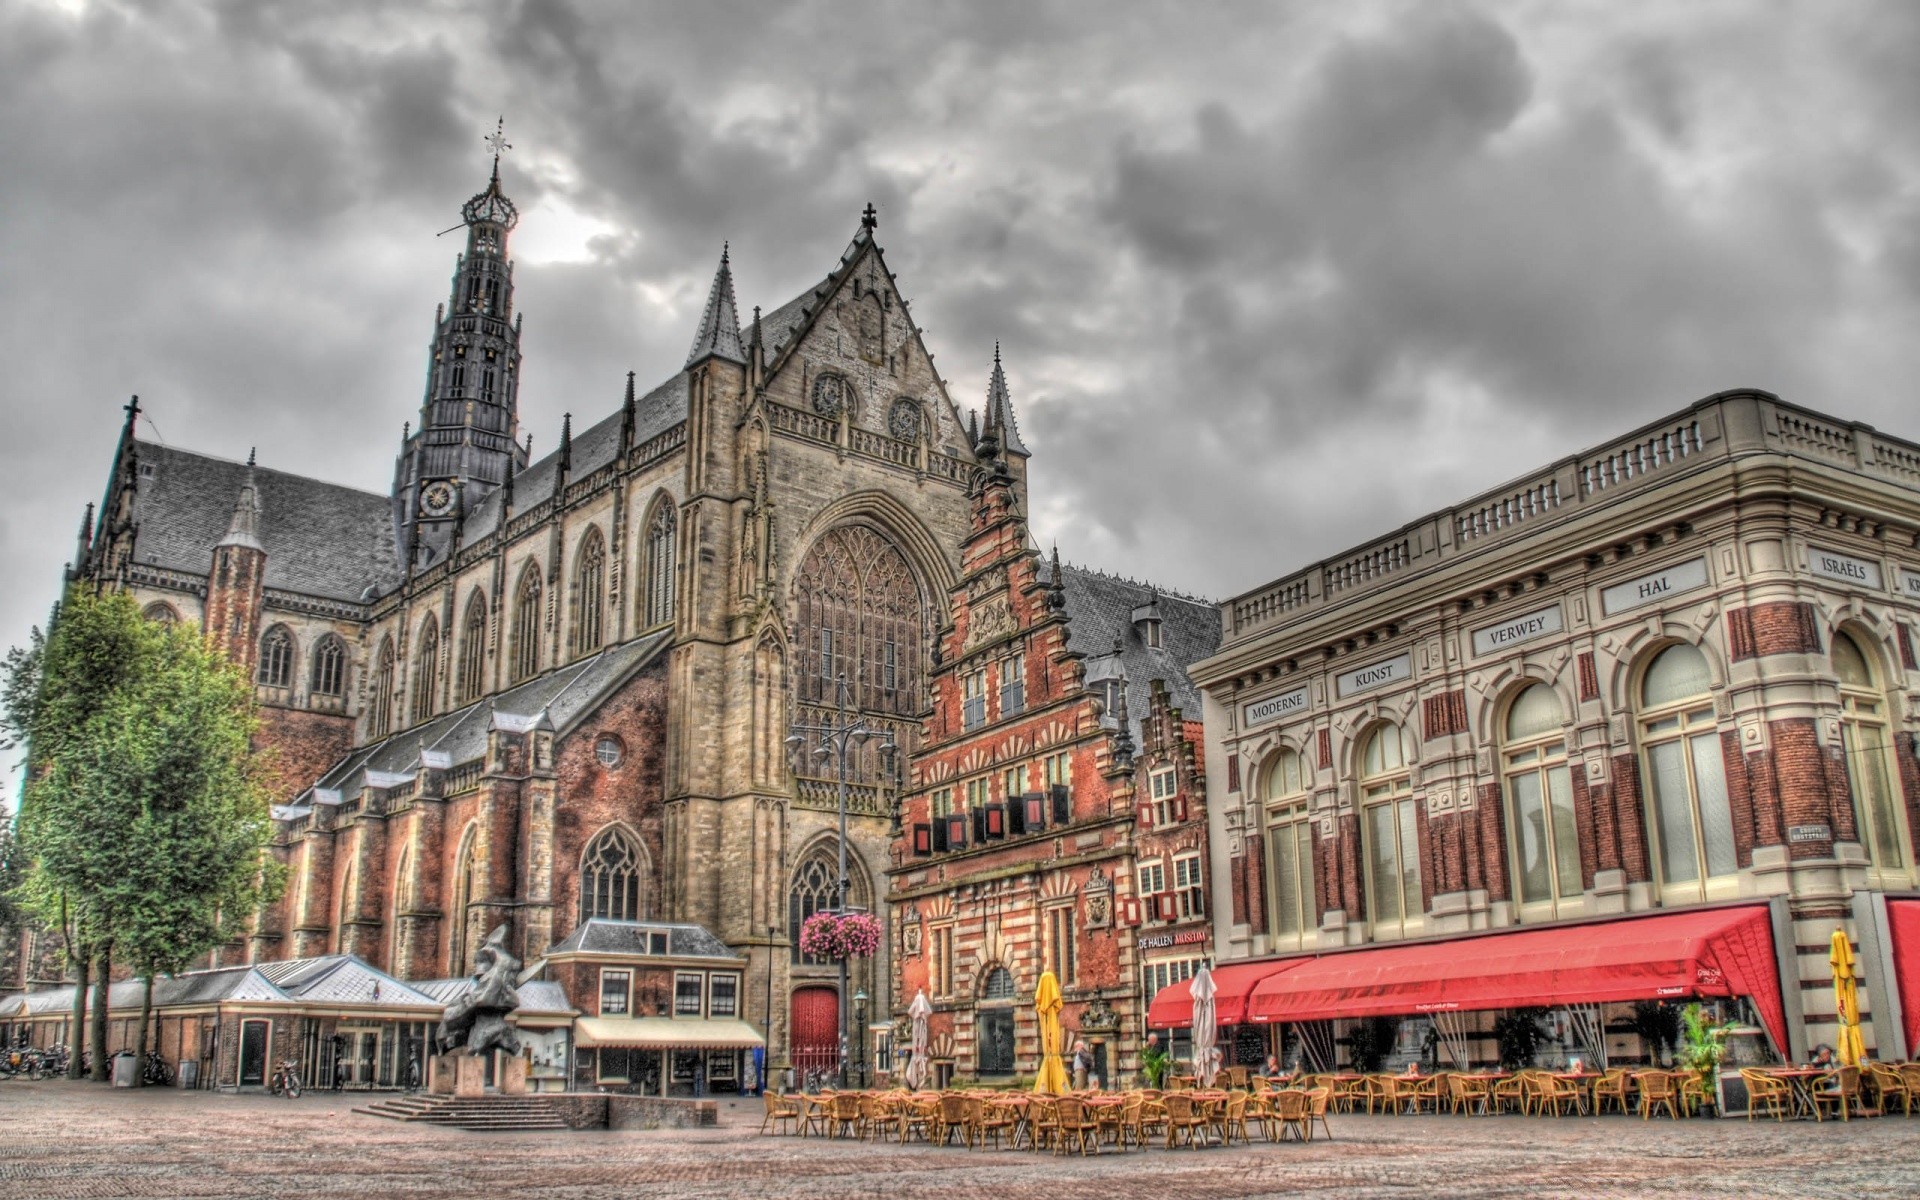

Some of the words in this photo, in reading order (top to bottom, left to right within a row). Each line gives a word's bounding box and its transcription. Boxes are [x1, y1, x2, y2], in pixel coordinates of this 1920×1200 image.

[1822, 557, 1866, 580] ISRAËLS
[1638, 577, 1672, 599] HAL
[1490, 616, 1546, 645] VERWEY
[1355, 665, 1394, 688] KUNST
[1252, 693, 1303, 720] MODERNE
[1138, 938, 1148, 949] DE
[1148, 935, 1173, 948] HALLEN
